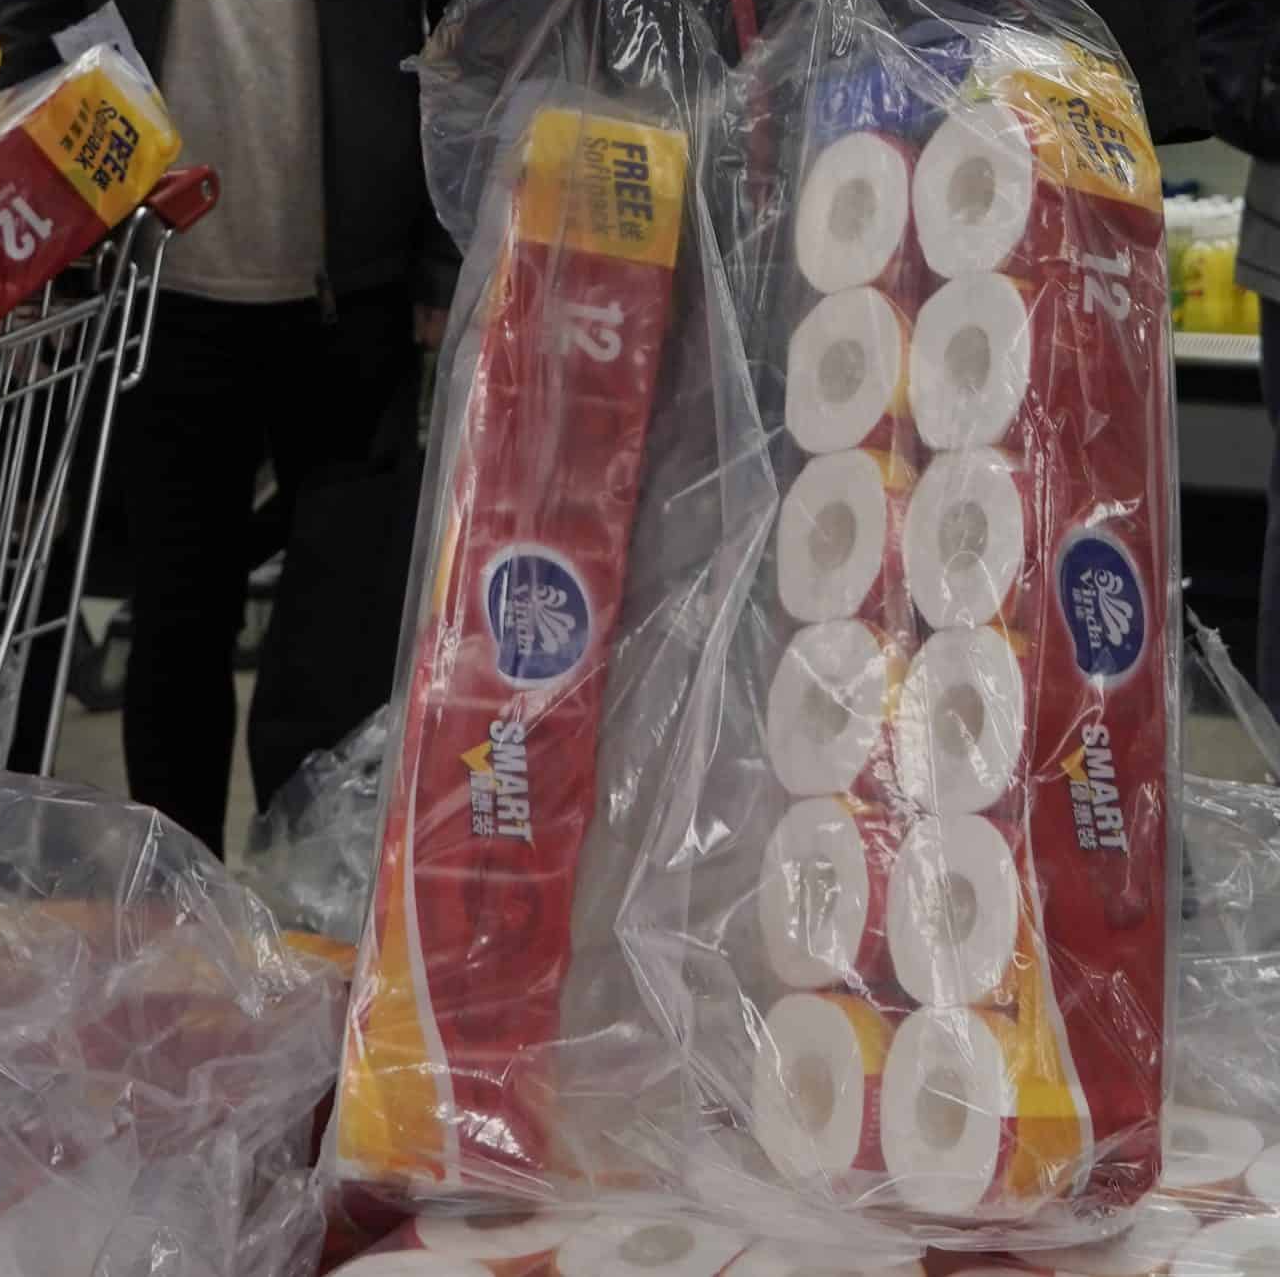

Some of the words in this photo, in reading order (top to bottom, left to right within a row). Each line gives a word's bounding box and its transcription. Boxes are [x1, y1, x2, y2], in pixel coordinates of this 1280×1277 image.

[611, 140, 653, 223] FREE
[1081, 252, 1132, 322] 12
[568, 300, 625, 363] 12
[511, 583, 535, 656] Vinda
[1079, 569, 1104, 649] Vinda
[489, 720, 535, 846] SMART
[1081, 723, 1129, 856] SMART
